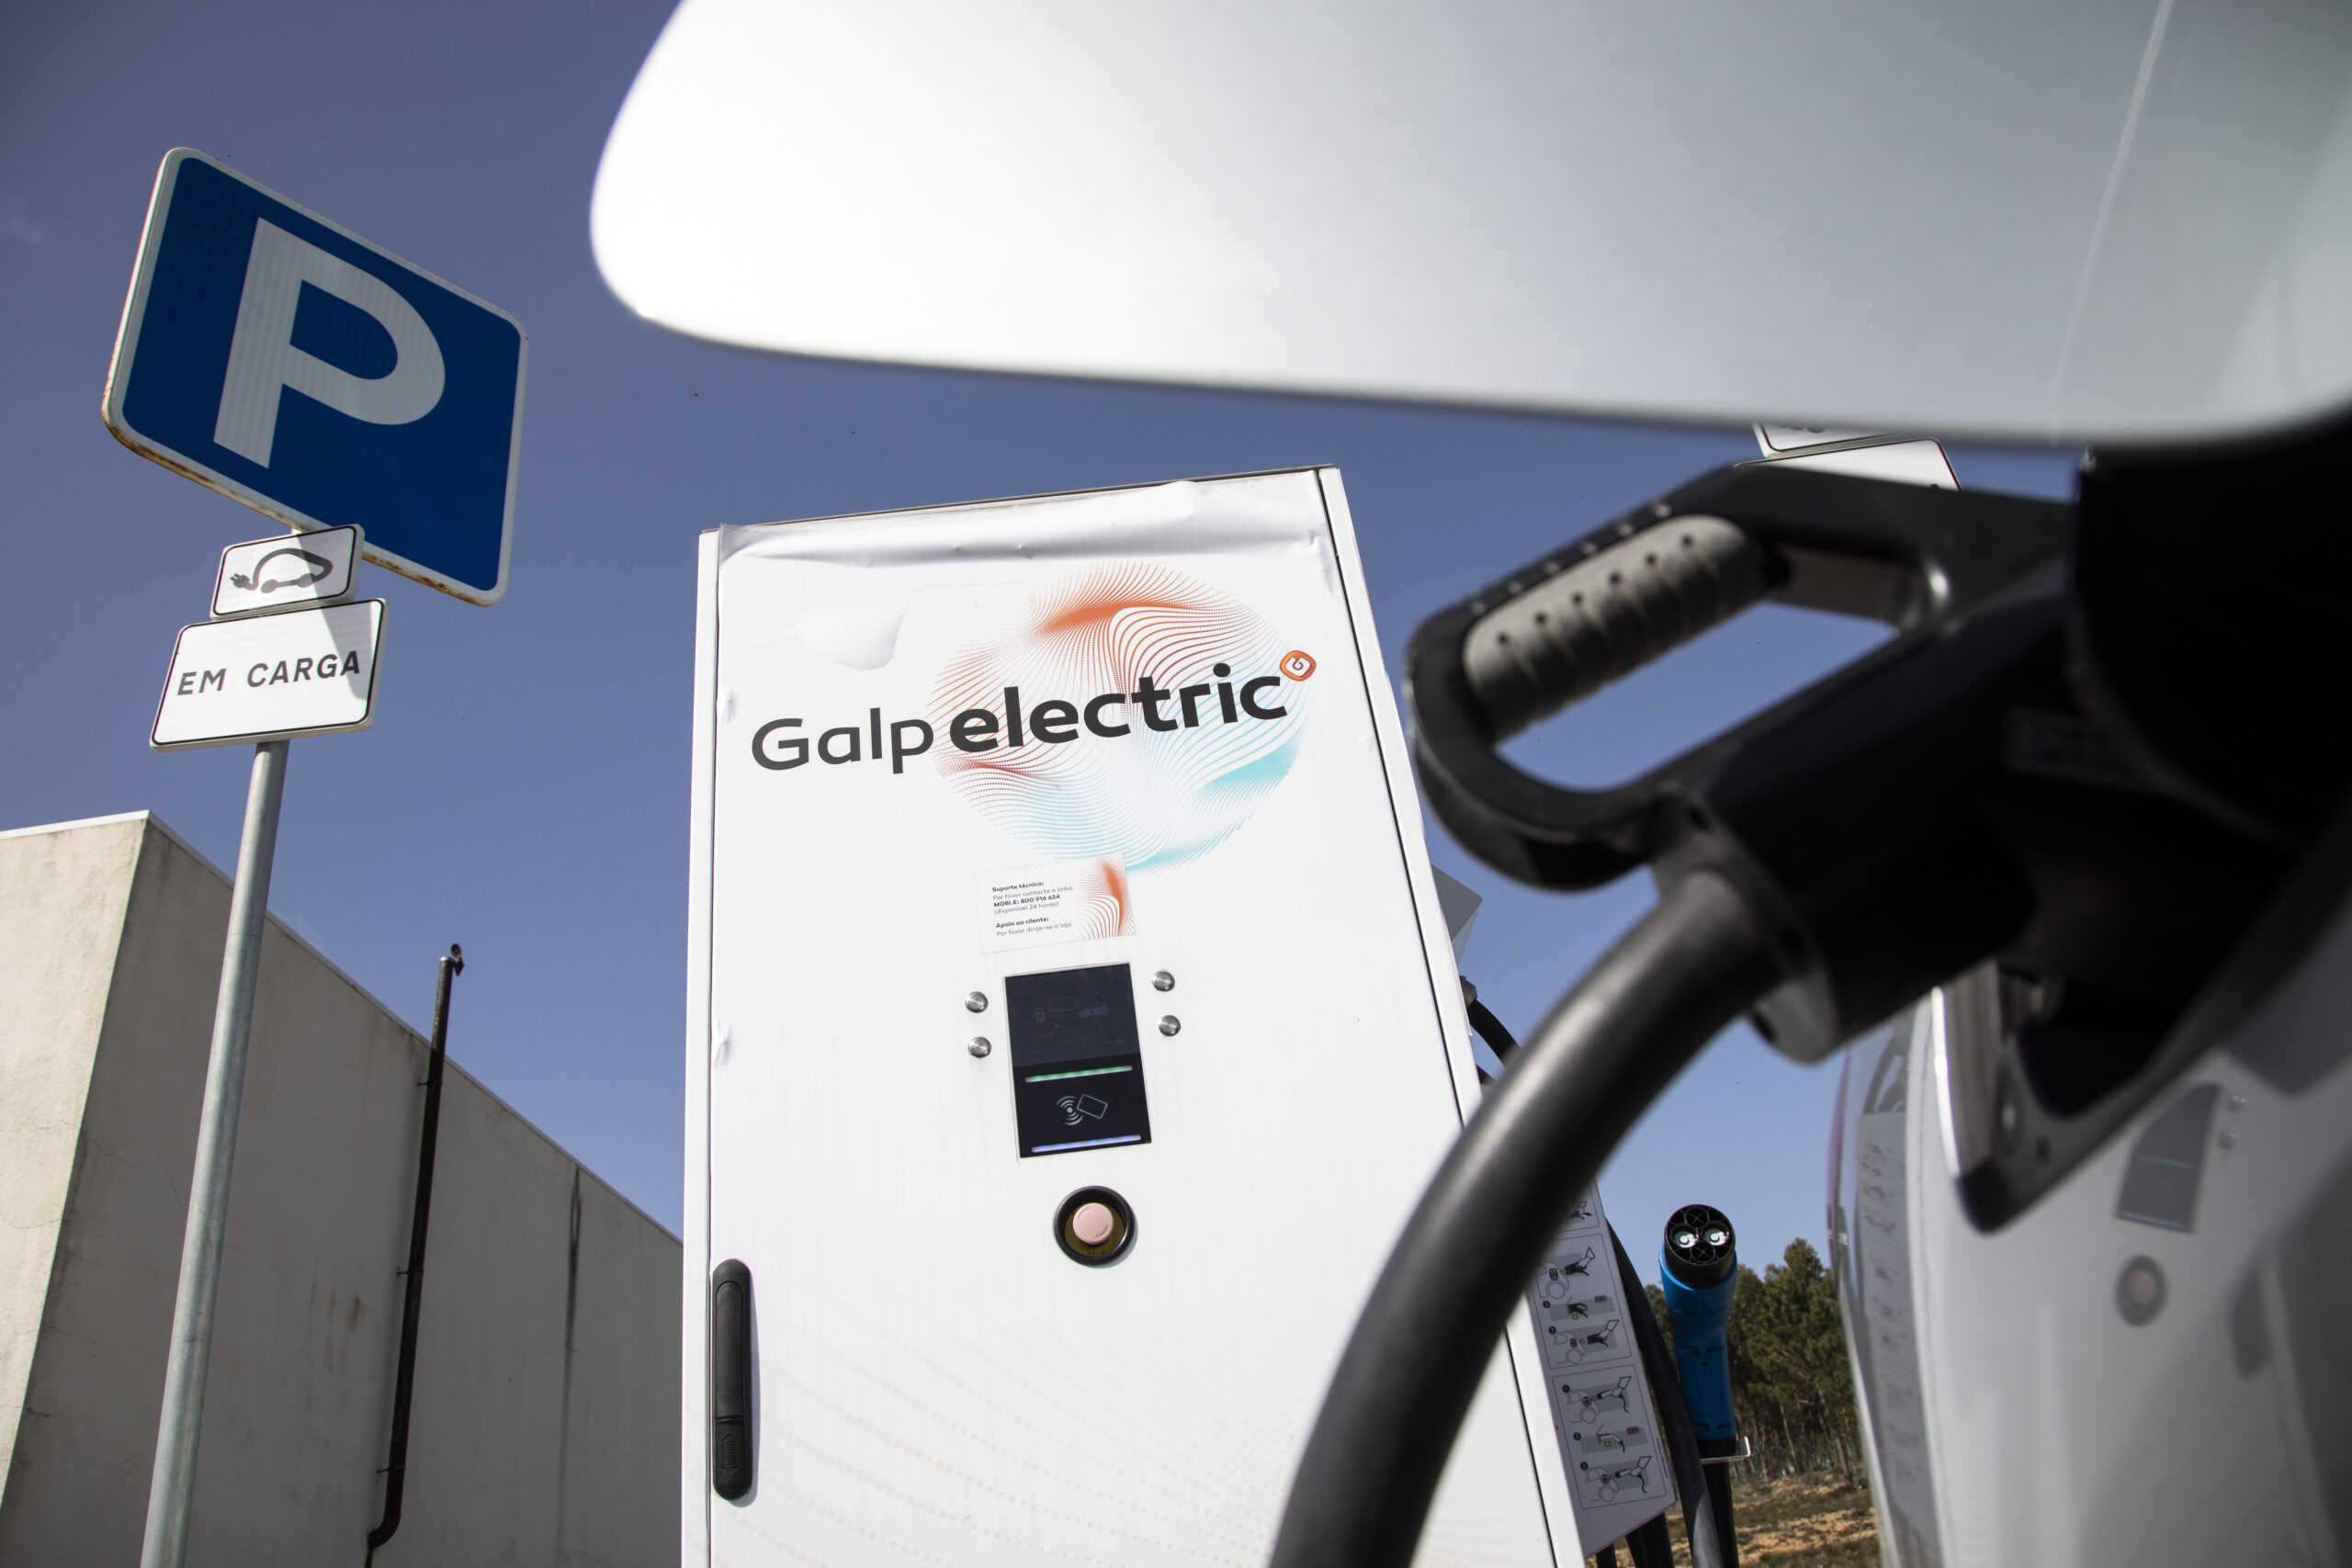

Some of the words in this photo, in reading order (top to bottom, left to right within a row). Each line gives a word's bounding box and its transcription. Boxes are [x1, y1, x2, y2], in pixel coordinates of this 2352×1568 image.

[212, 217, 446, 469] P
[176, 668, 227, 695] EM
[246, 650, 361, 687] CARGA
[750, 706, 935, 774] Galp
[948, 662, 1288, 754] electric
